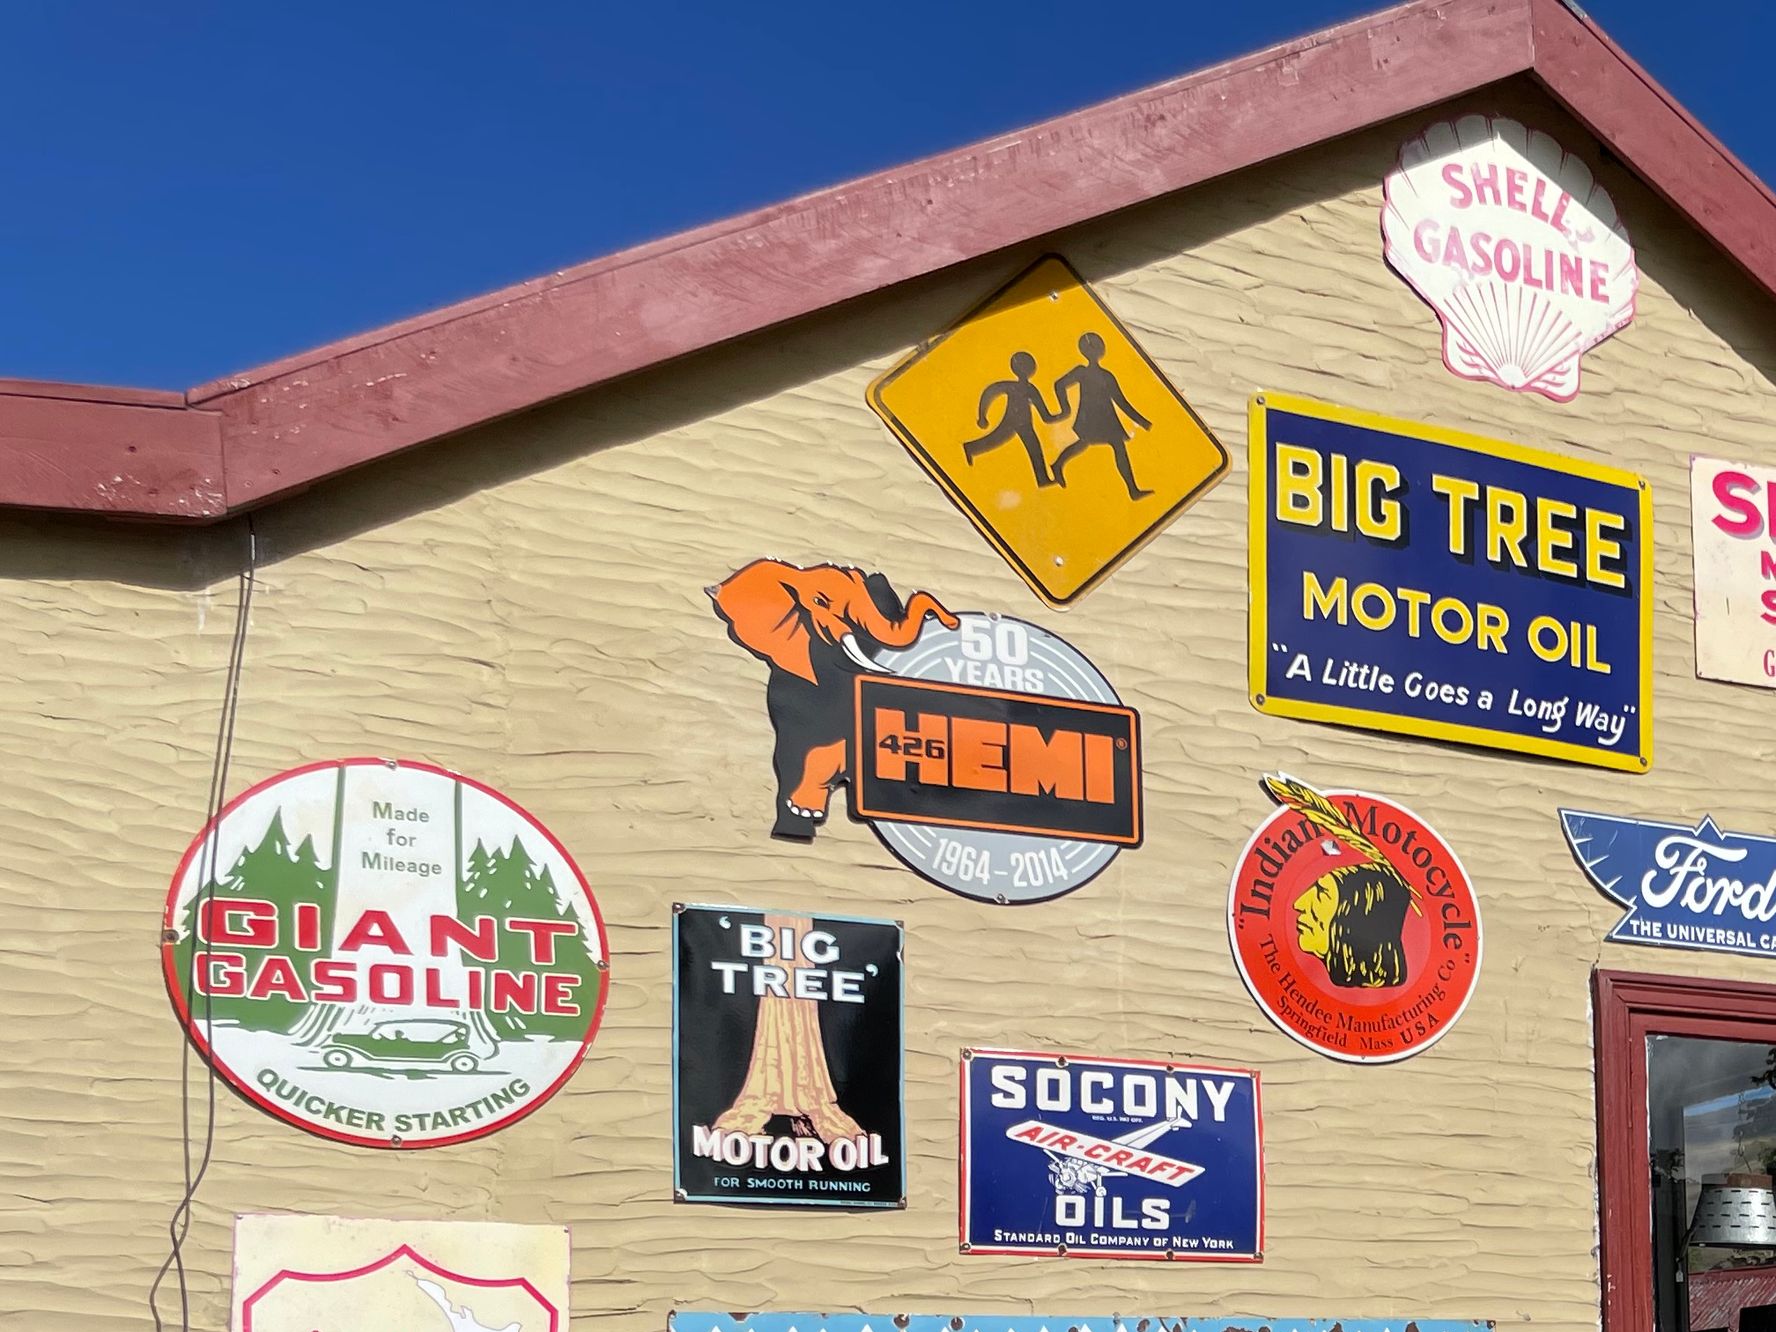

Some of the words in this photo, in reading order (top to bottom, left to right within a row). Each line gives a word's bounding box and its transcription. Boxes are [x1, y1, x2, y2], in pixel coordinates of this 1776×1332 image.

[1442, 163, 1572, 236] SHELL
[1413, 218, 1609, 304] GASOLINE
[1275, 443, 1401, 541] BIG
[1432, 474, 1626, 589] TREE
[960, 618, 1029, 666] 50
[1302, 571, 1509, 654] MOTOR
[1527, 615, 1611, 674] OIL
[944, 657, 1043, 693] YEARS
[1322, 658, 1395, 694] Little
[1404, 671, 1469, 706] Goes
[1478, 691, 1494, 710] a
[1508, 689, 1569, 733] Long
[875, 707, 1115, 804] HEMI
[879, 734, 945, 759] 426
[372, 800, 430, 824] Made
[386, 828, 417, 848] for
[361, 851, 443, 877] Mileage
[200, 896, 578, 965] GIANT
[1630, 920, 1662, 938] THE
[1667, 924, 1756, 949] UNIVERSAL
[194, 952, 582, 1017] GASOLINE
[1260, 933, 1280, 974] The
[1278, 971, 1333, 1024] Hendee
[1336, 982, 1446, 1033] Manufacturing
[1437, 959, 1456, 981] Co
[1277, 995, 1347, 1047] Springfield
[1360, 1037, 1394, 1050] Mass
[256, 1067, 386, 1132] QUICKER
[394, 1077, 531, 1133] STARTING
[991, 1064, 1236, 1122] SOCONY
[692, 1124, 824, 1173] MOTOR
[828, 1132, 889, 1172] OIL
[747, 1177, 803, 1190] SMOOTH
[808, 1180, 871, 1193] RUNNING
[1055, 1194, 1170, 1230] OILS
[994, 1229, 1060, 1244] STANDARD
[1065, 1232, 1086, 1245] OIL
[1090, 1233, 1150, 1247] COMPANY
